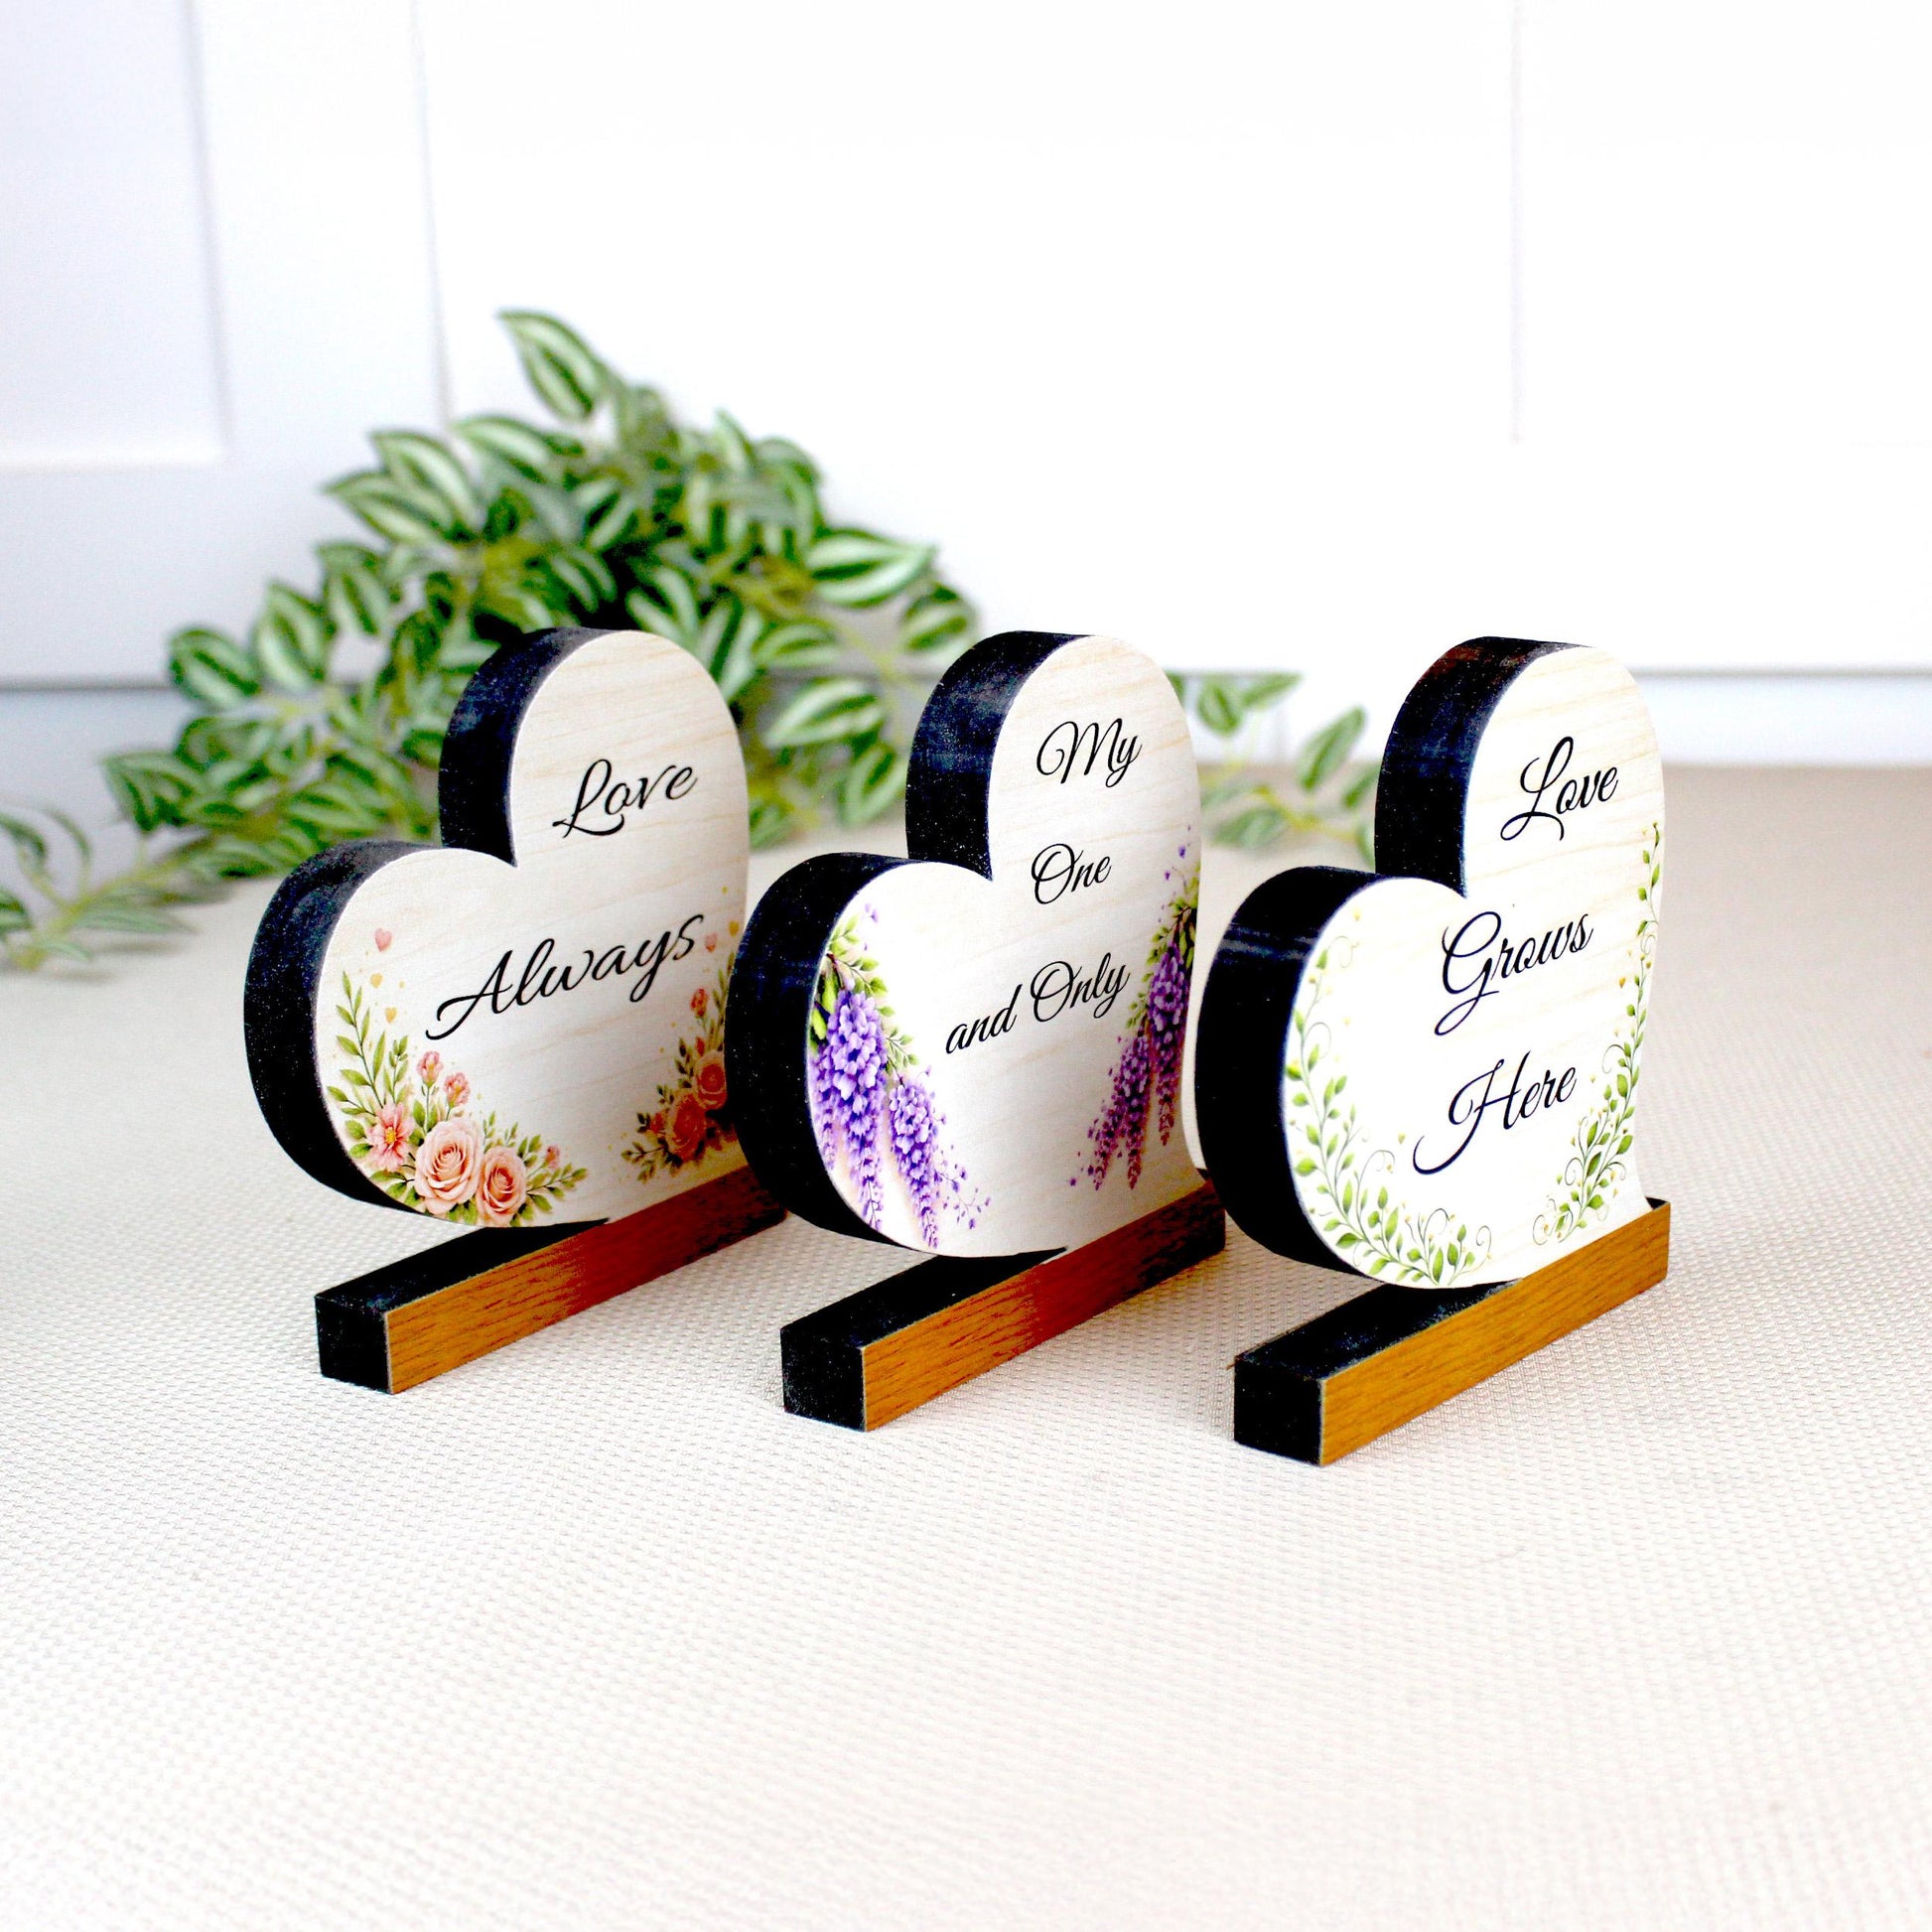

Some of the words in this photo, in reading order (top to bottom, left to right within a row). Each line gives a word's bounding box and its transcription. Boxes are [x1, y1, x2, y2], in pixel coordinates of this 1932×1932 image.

[552, 758, 699, 840] Love
[1035, 717, 1142, 788] My
[1499, 735, 1619, 842] Love
[1031, 842, 1112, 905] One
[425, 912, 705, 1040] Always
[944, 982, 1024, 1055] and
[1030, 952, 1132, 1023] Only
[1434, 909, 1594, 1036] Grows
[1412, 1049, 1578, 1175] Here
